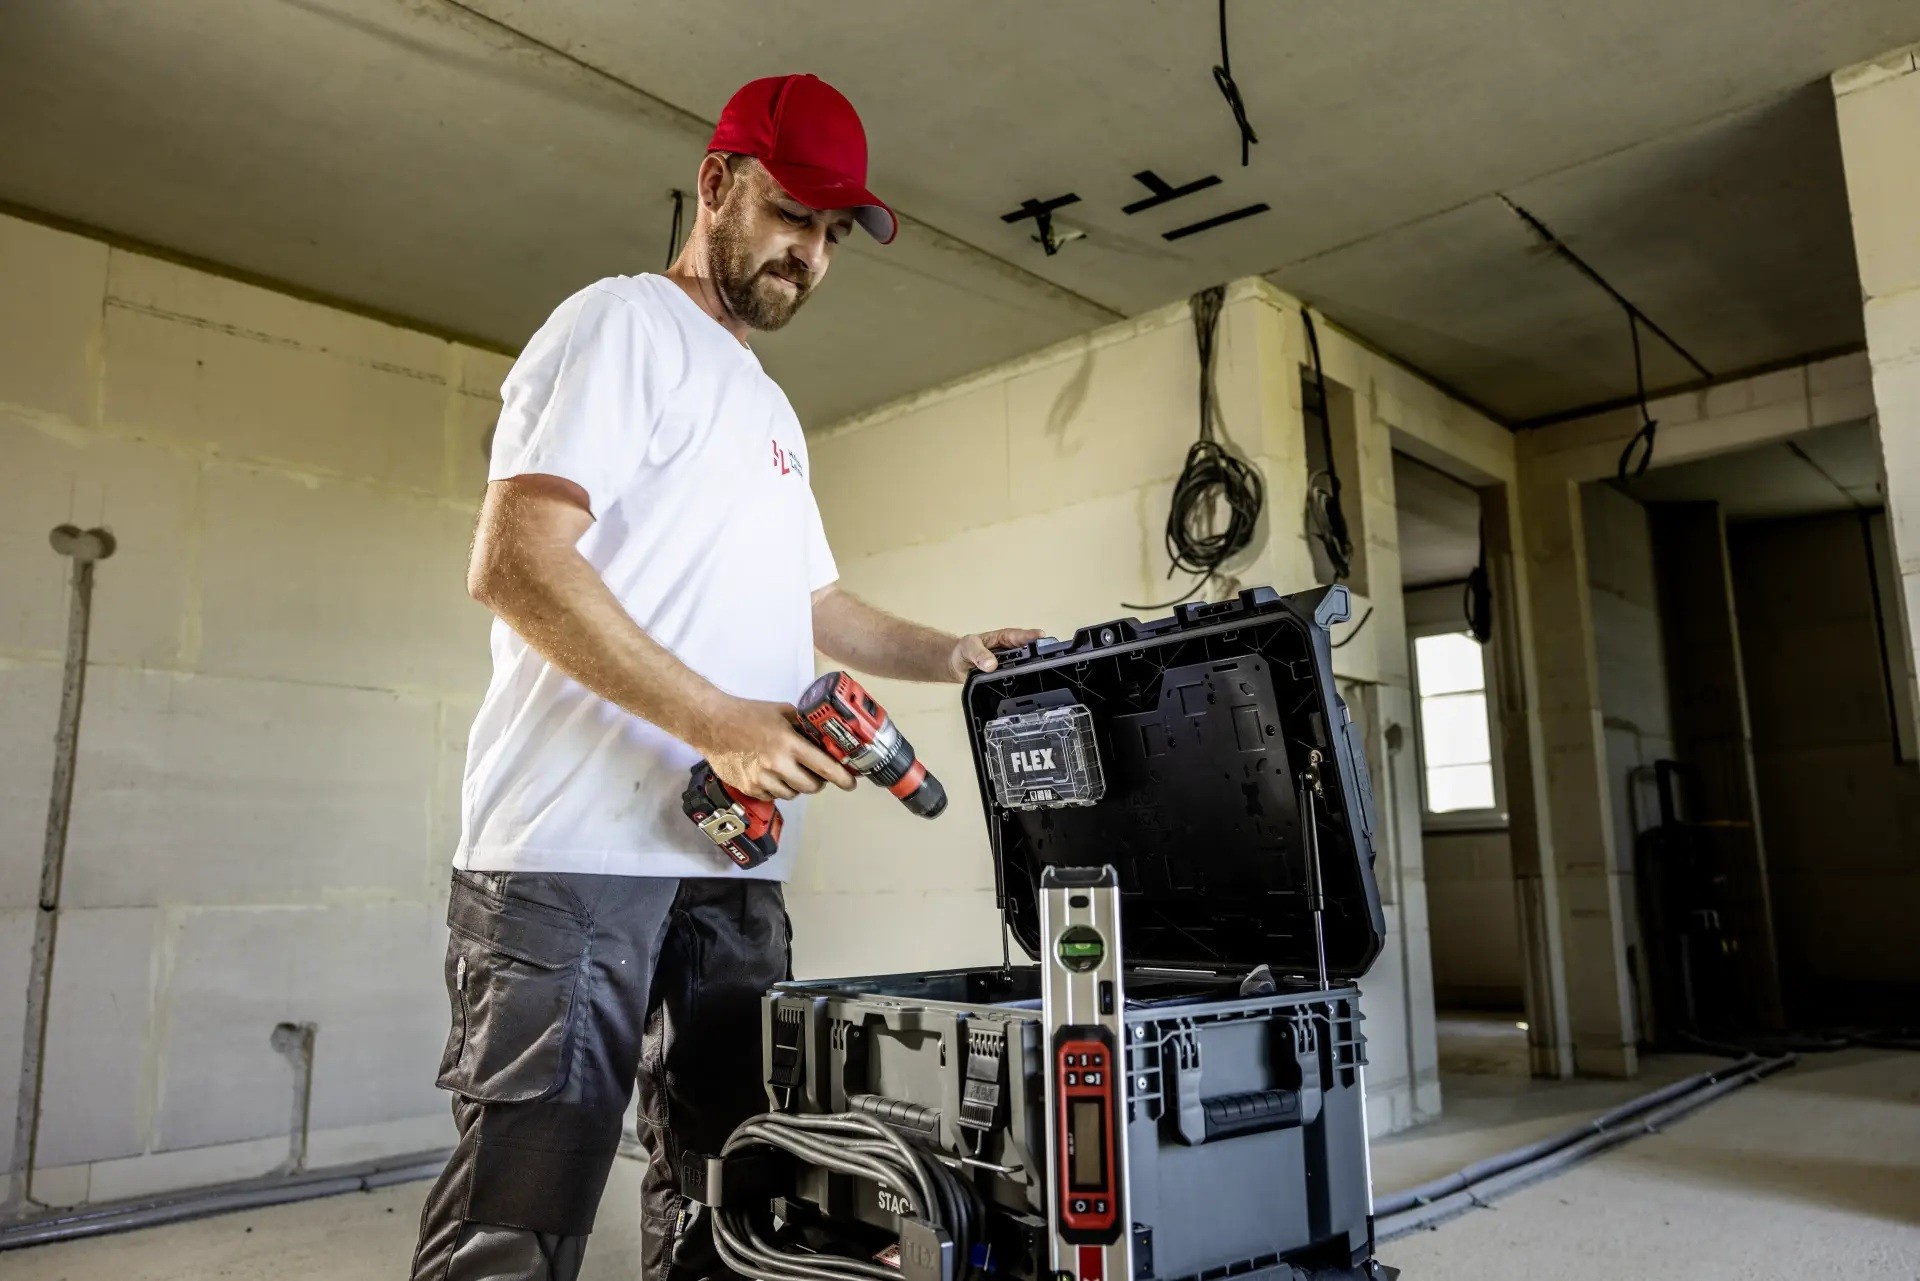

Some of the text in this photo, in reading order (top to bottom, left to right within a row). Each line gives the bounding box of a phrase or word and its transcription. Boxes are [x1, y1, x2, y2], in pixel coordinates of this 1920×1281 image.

[1011, 748, 1057, 773] FLEX
[728, 846, 747, 861] FLEX
[904, 1237, 935, 1270] FLEX
